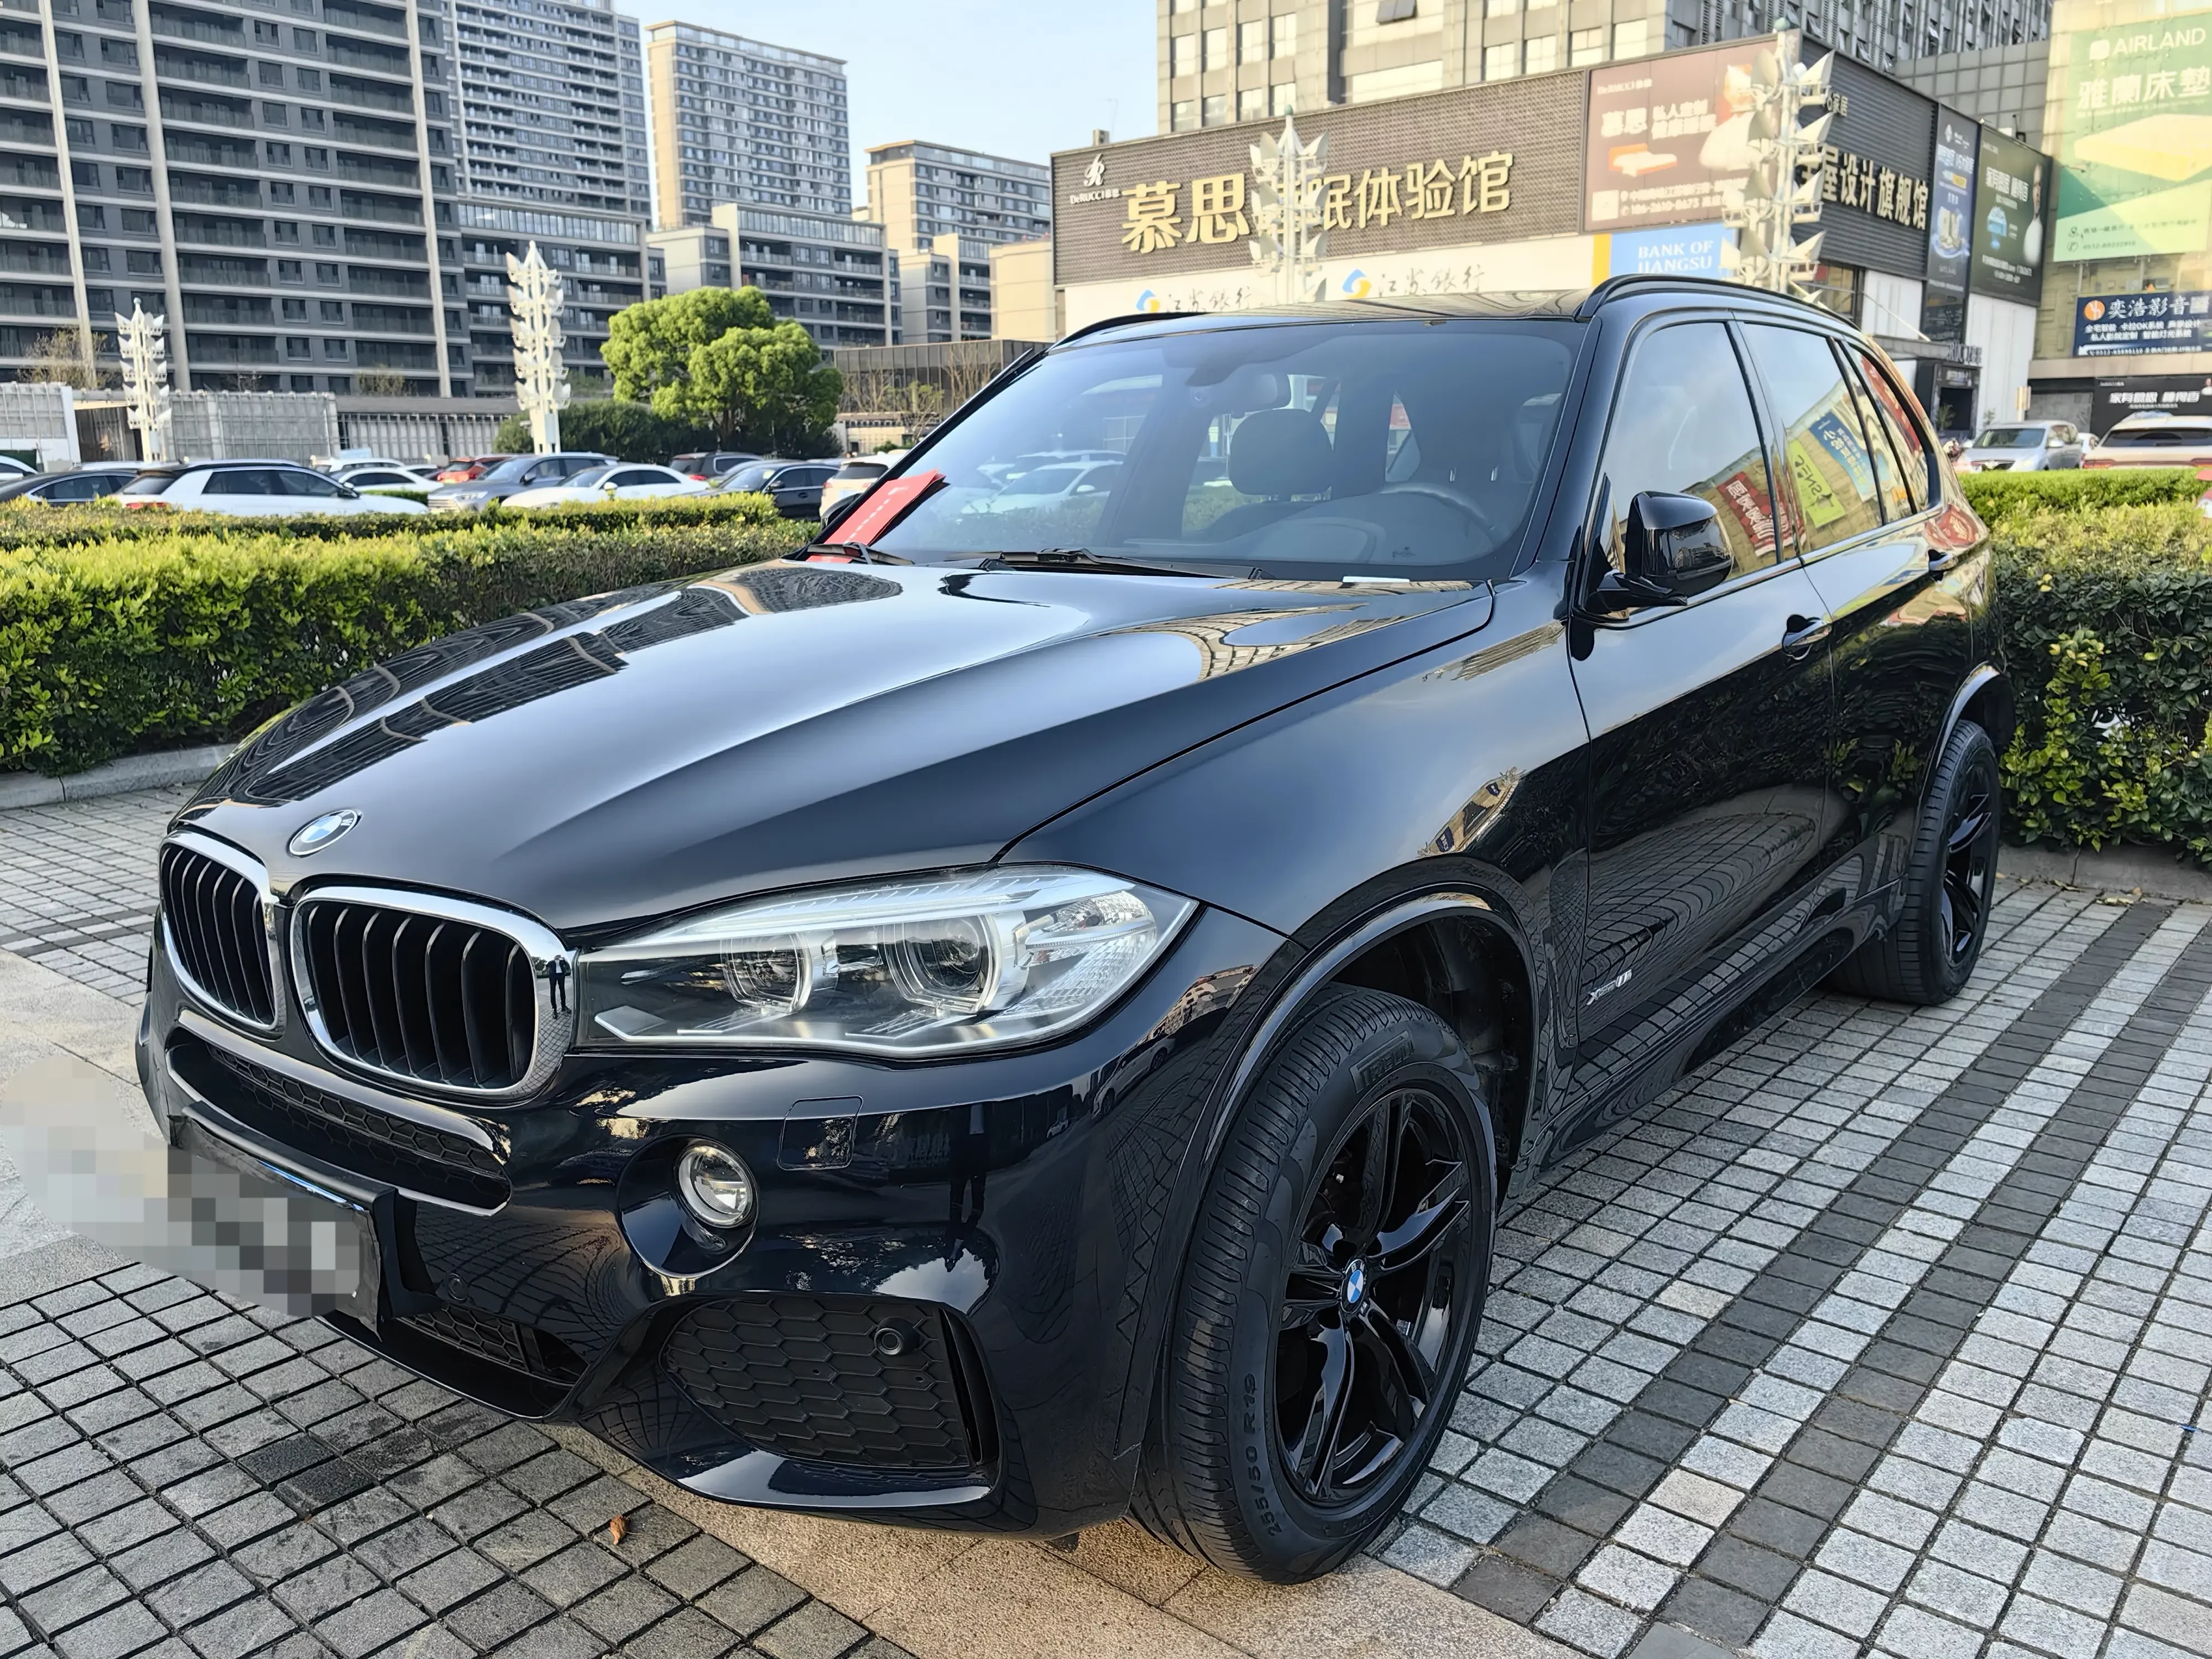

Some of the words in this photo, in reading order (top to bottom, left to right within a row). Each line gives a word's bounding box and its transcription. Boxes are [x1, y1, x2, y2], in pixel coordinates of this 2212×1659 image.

[2112, 28, 2206, 56] AIRLAND
[1638, 243, 1685, 259] BANK
[1690, 240, 1714, 254] OF
[2107, 295, 2190, 321] 奕浩影音
